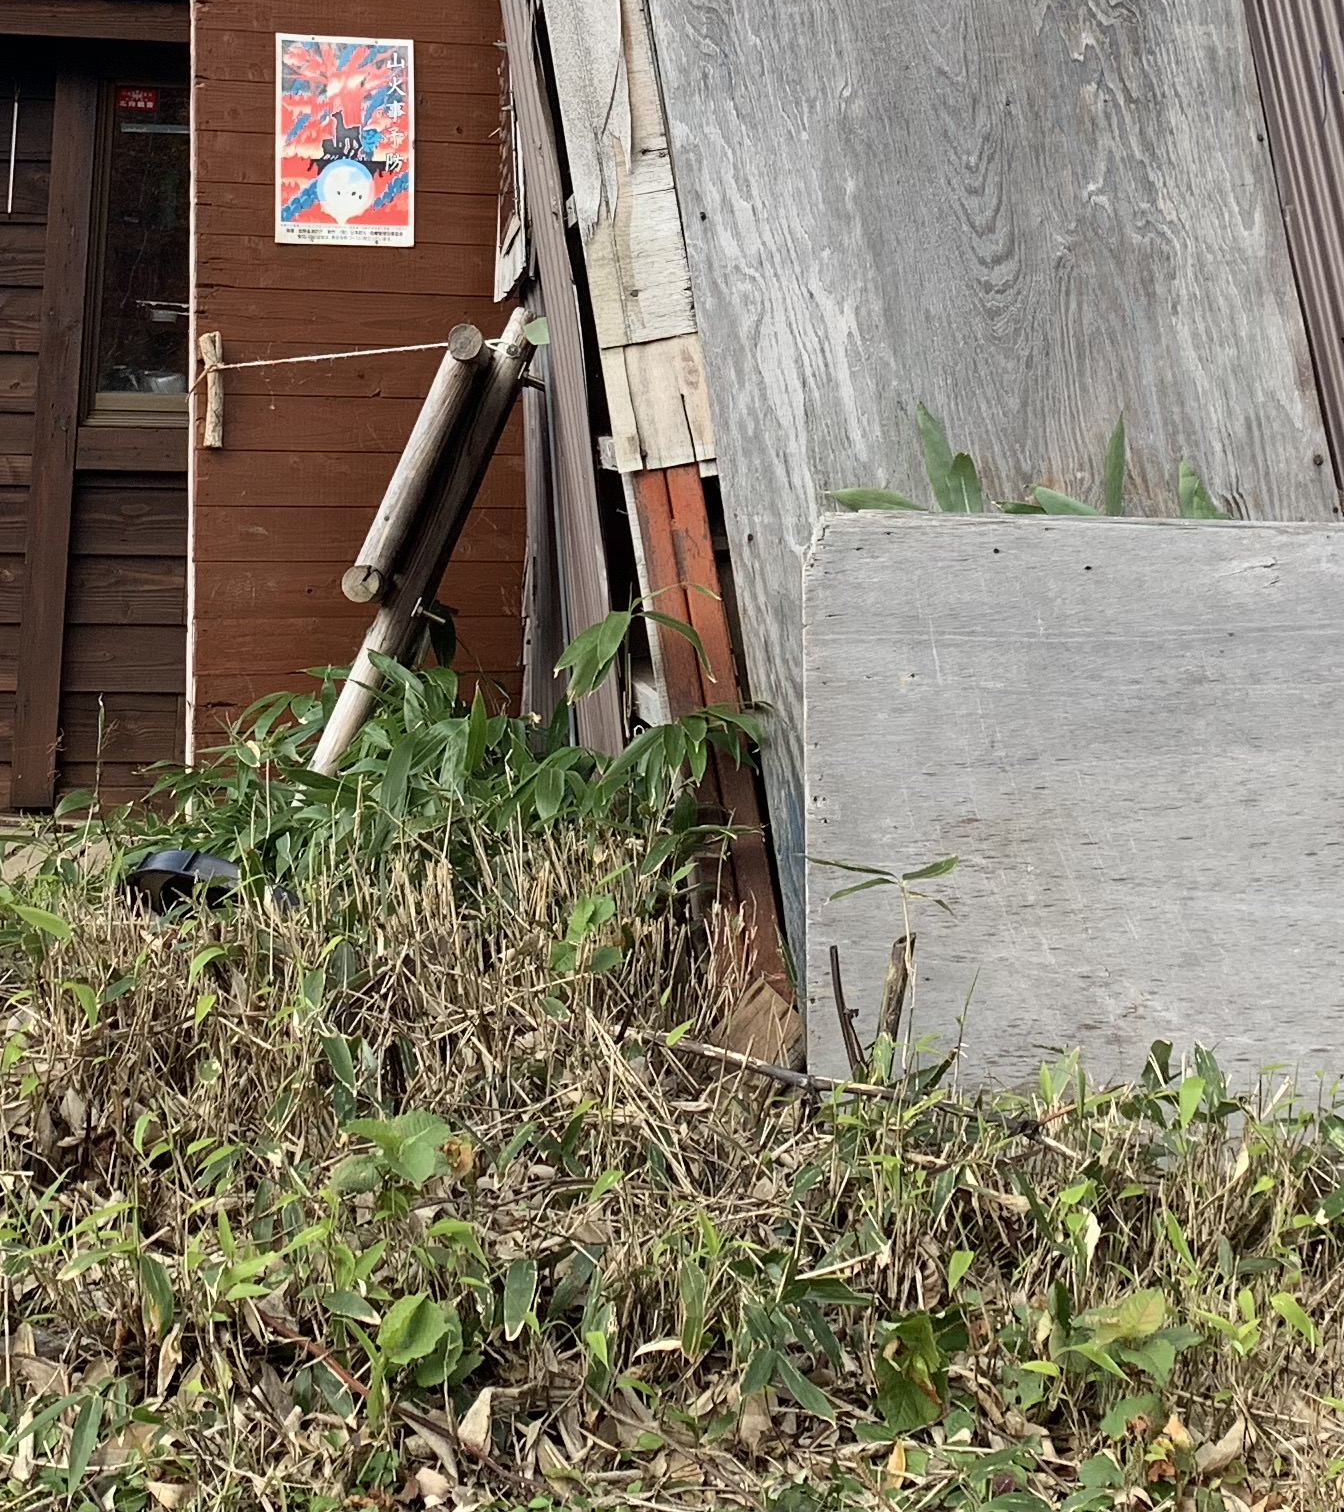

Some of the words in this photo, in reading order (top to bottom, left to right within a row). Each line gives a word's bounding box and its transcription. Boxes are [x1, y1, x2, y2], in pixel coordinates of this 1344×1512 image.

[385, 52, 406, 171] 山火事予防
